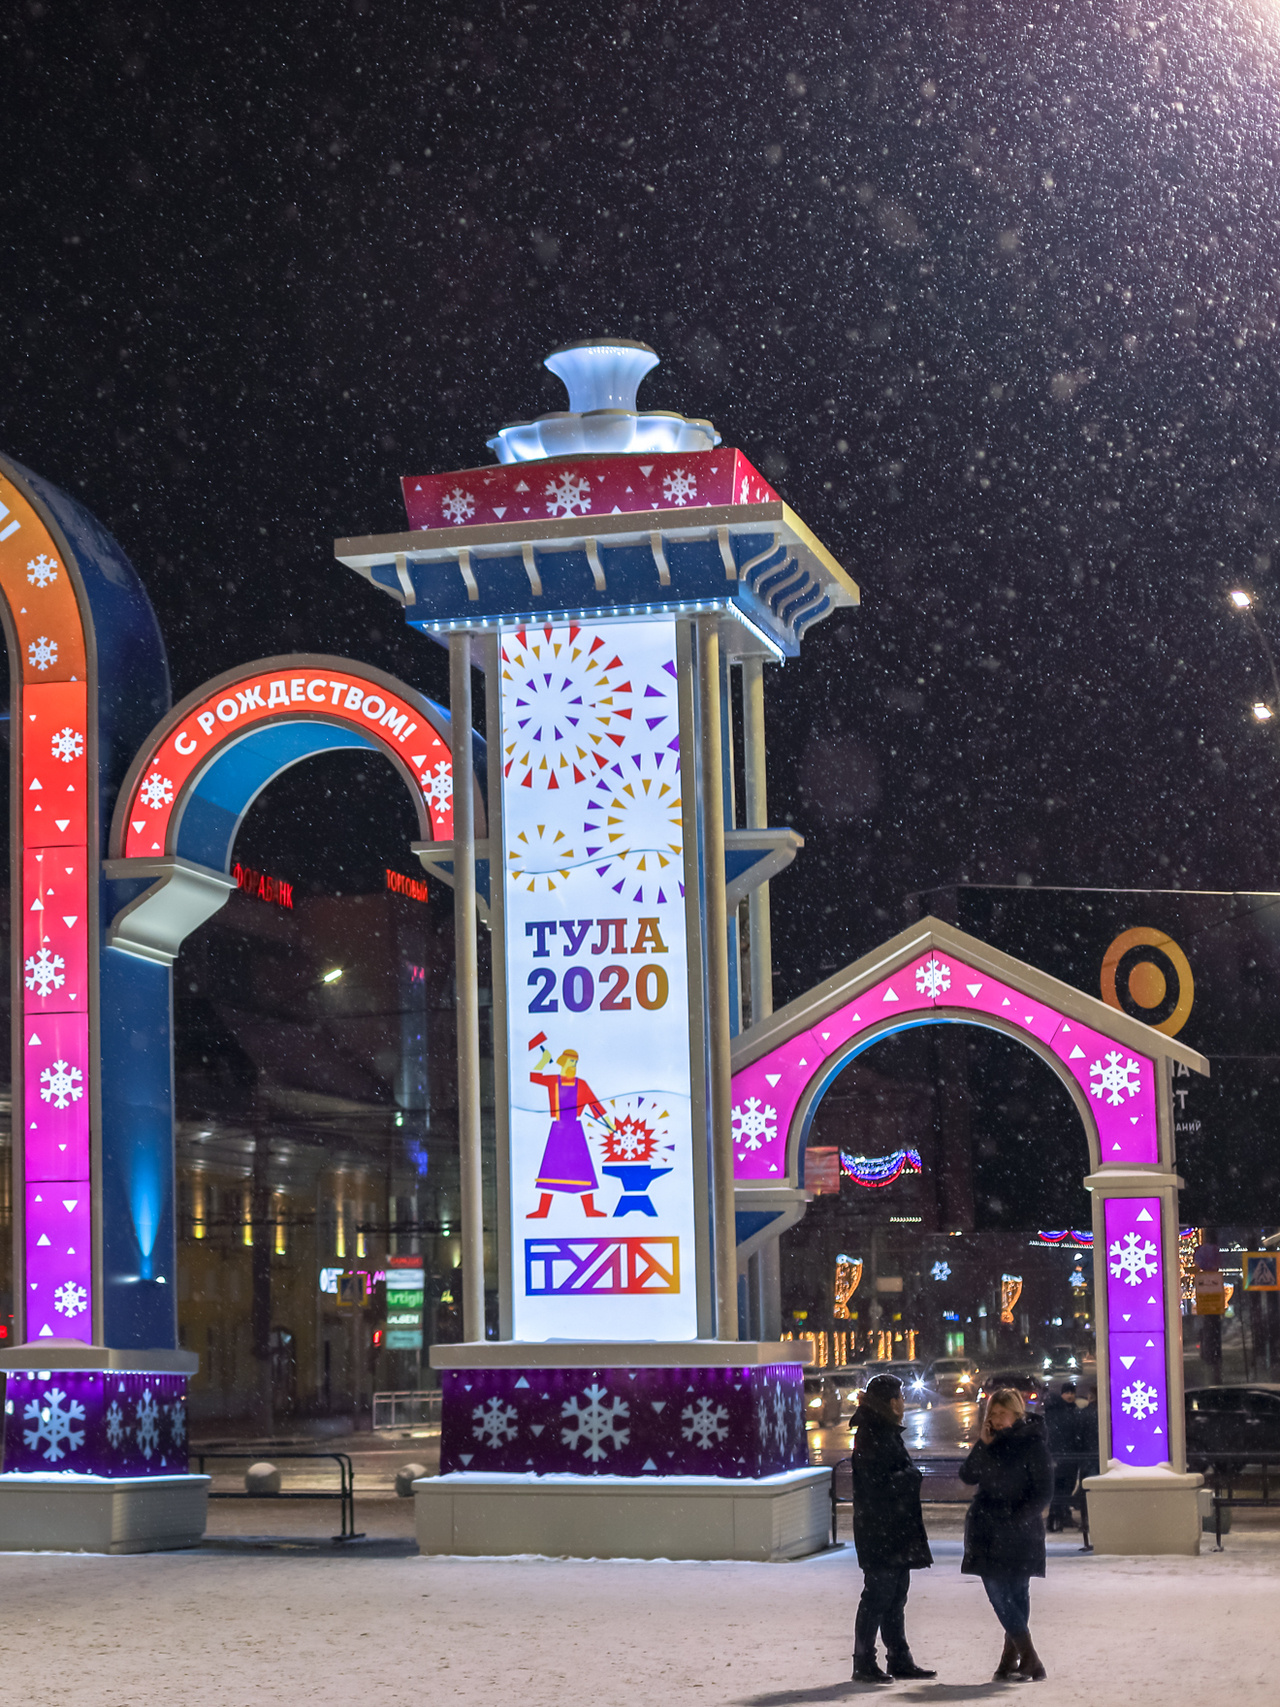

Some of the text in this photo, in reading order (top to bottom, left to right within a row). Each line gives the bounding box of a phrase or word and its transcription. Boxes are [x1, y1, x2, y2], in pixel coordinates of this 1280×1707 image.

[174, 678, 417, 755] С РОЖДЕСТВОМ!
[386, 869, 428, 903] ТОРГОВЫЙ
[525, 917, 669, 957] ТУЛА
[527, 963, 669, 1014] 2020
